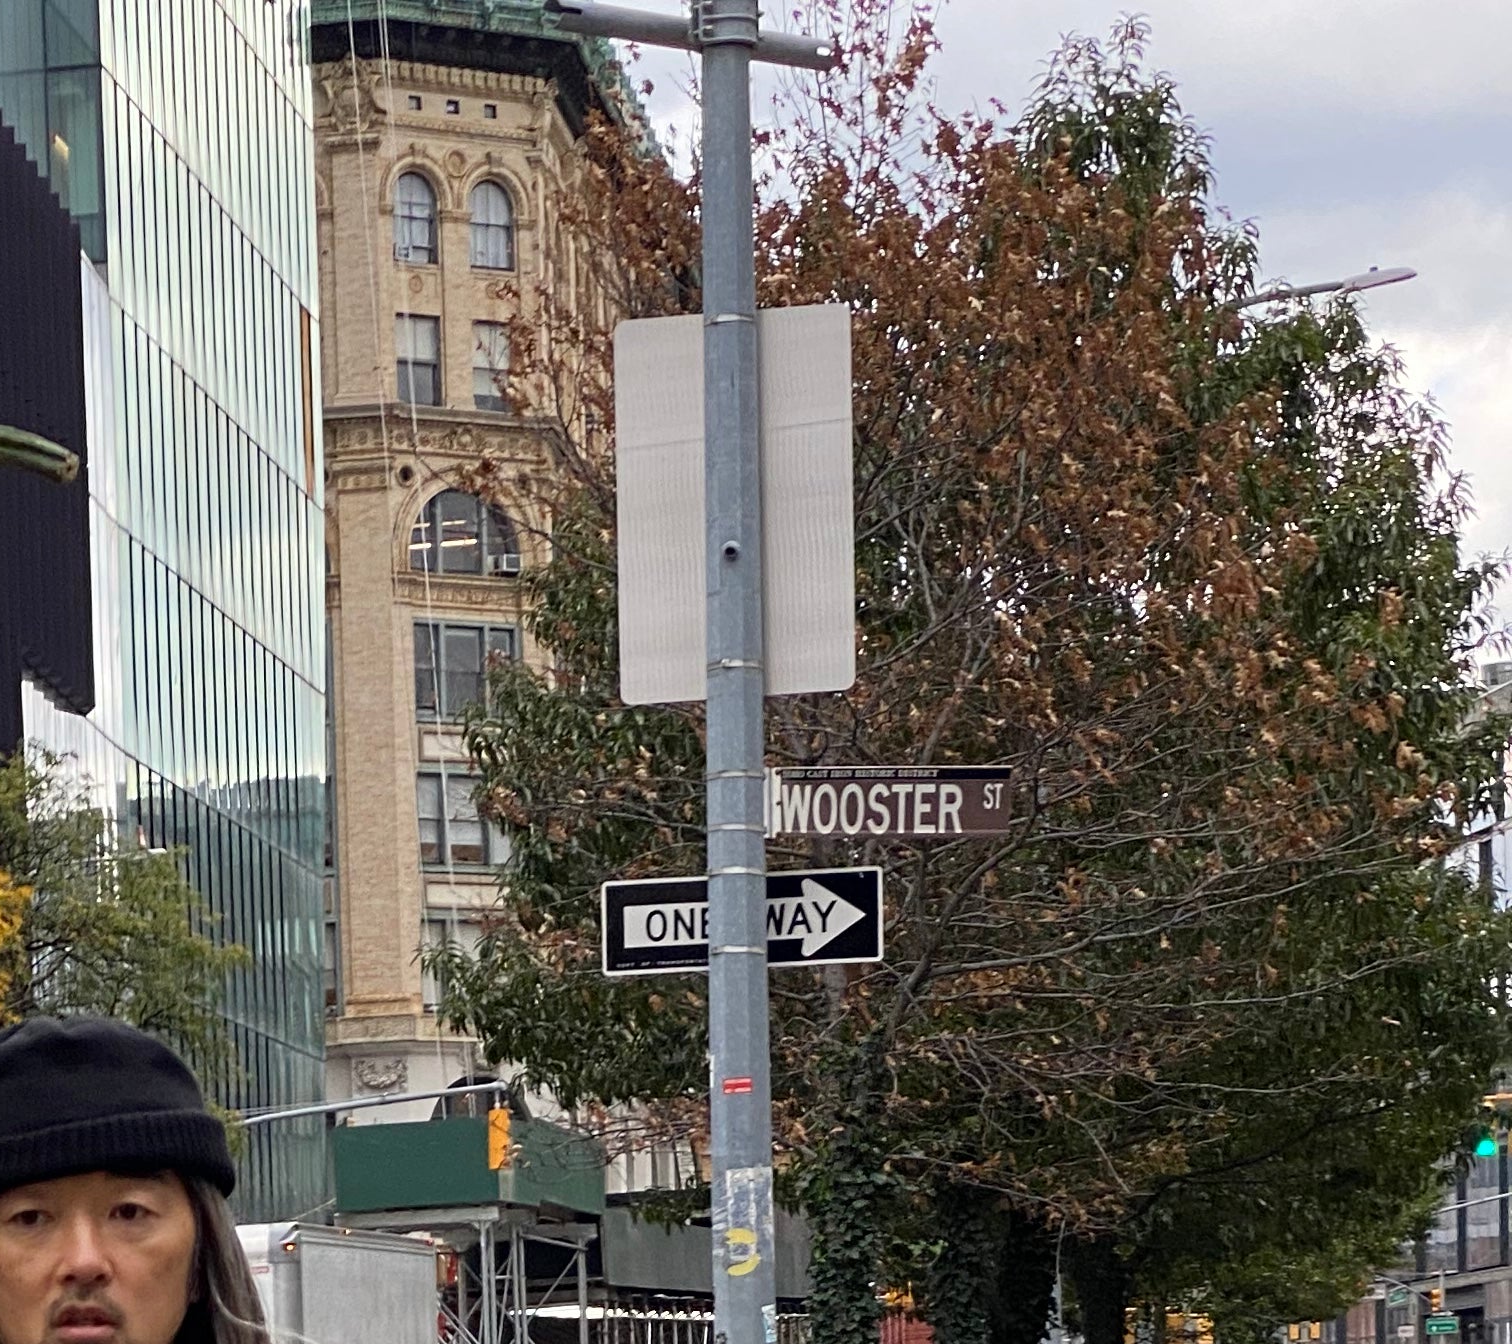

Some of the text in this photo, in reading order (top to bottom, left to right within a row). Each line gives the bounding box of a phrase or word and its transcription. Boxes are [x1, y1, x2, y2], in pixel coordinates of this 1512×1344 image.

[781, 783, 1003, 835] WOOSTER ST
[766, 900, 837, 935] WAY
